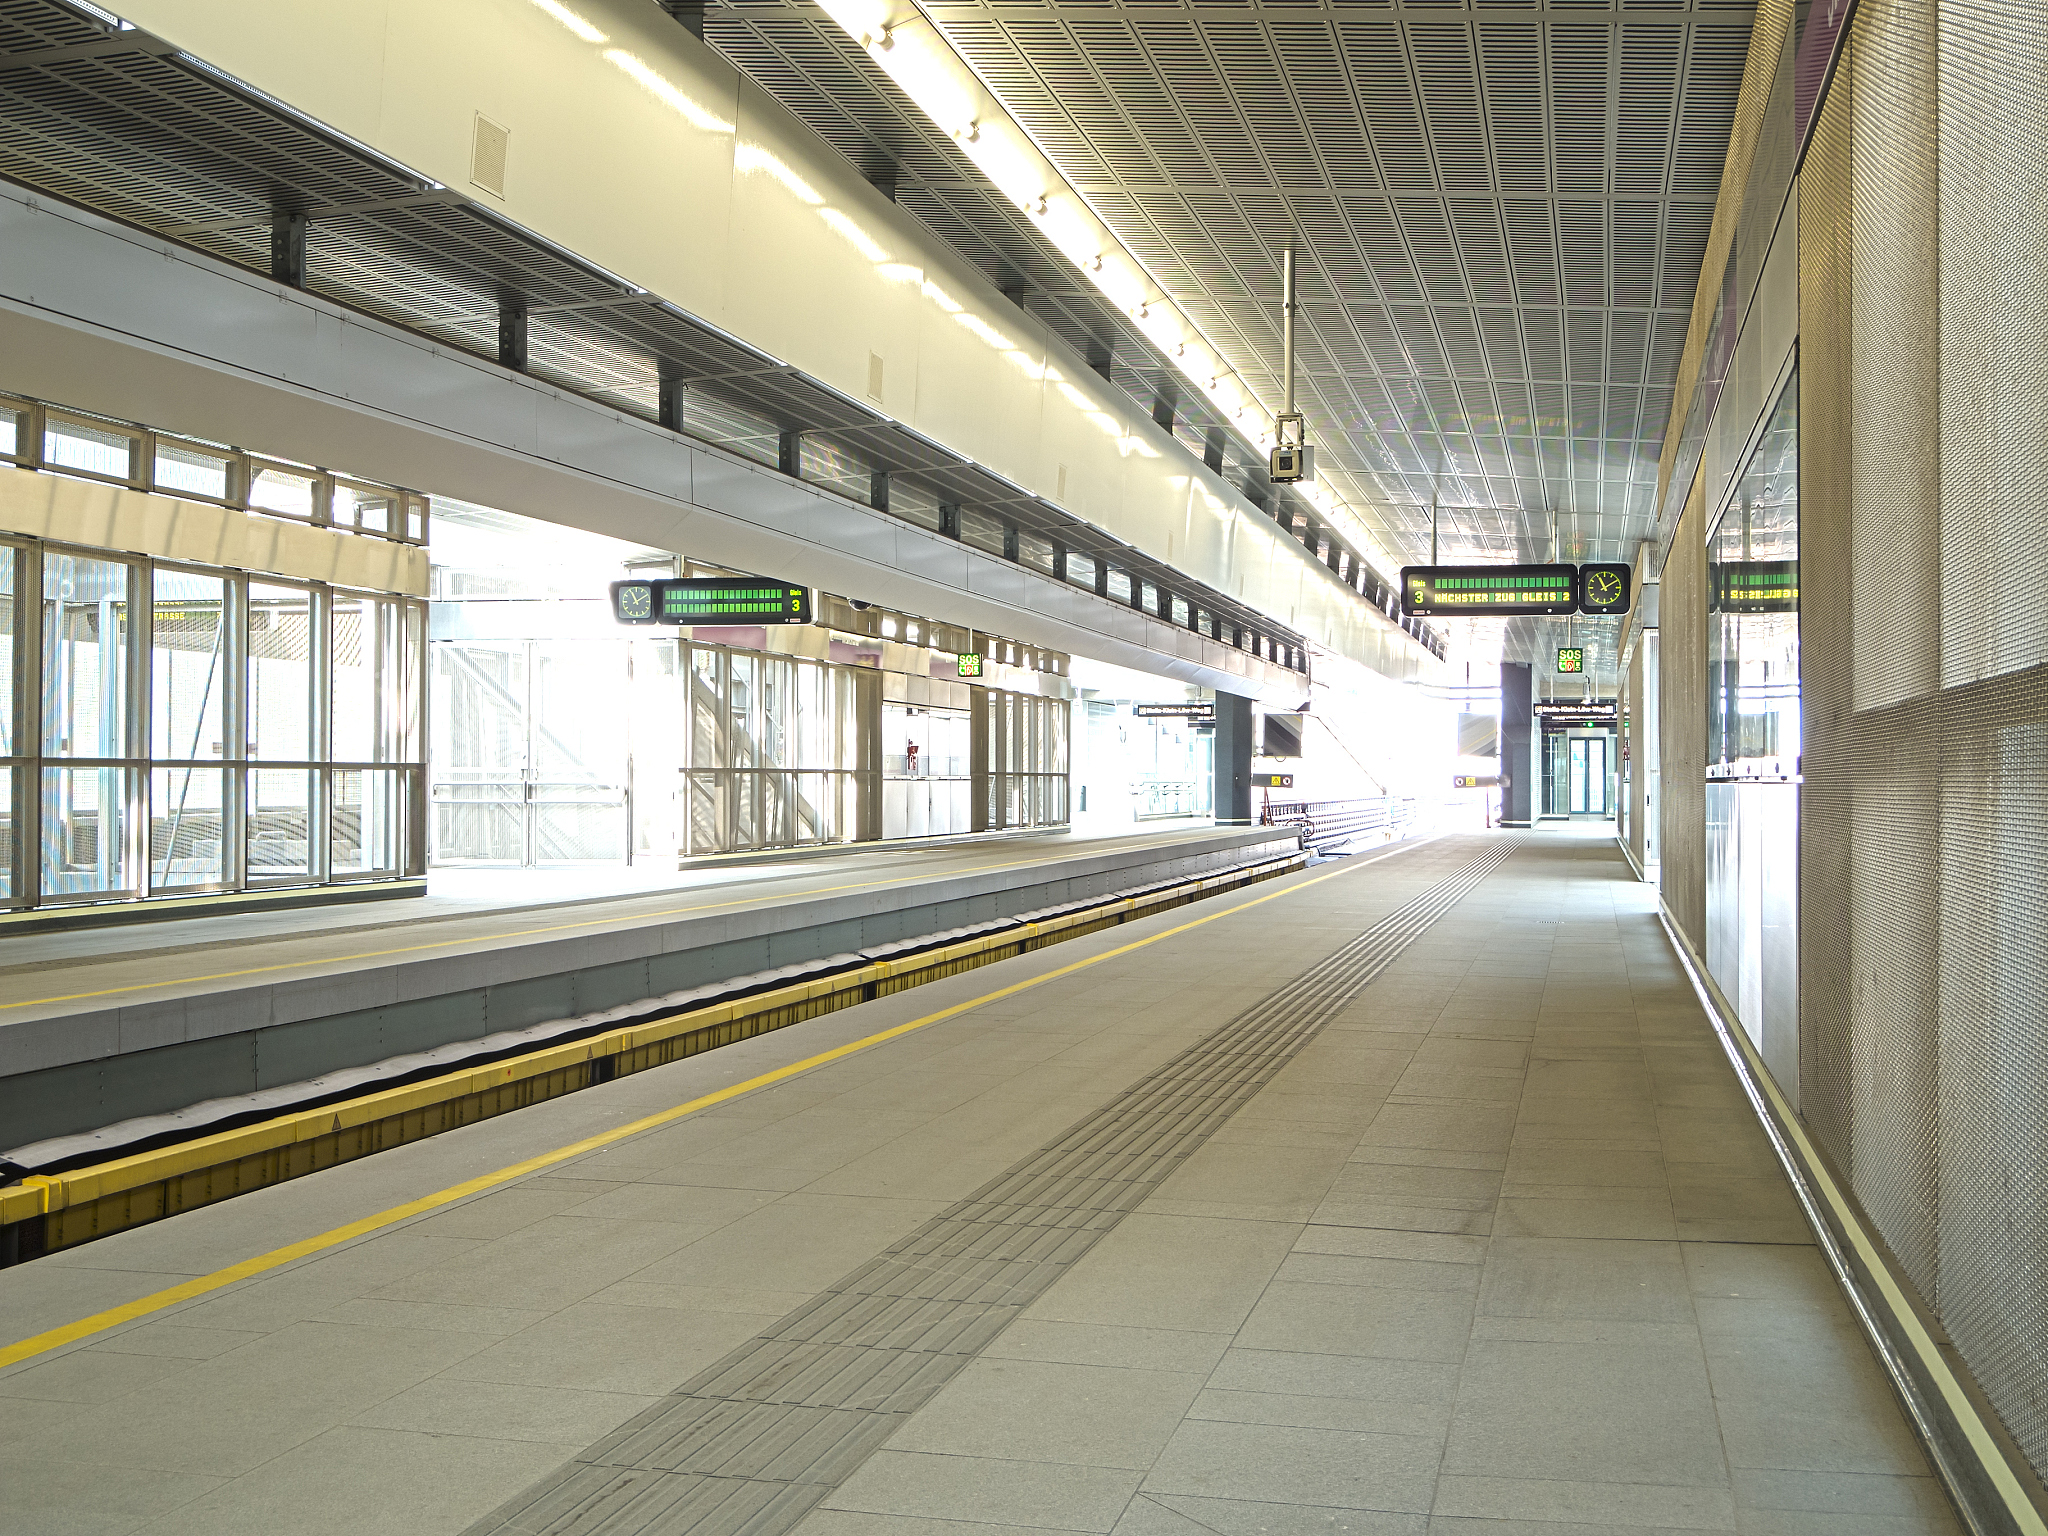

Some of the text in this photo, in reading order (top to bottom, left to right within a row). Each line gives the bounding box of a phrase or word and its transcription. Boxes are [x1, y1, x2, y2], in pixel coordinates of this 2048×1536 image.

[1414, 590, 1424, 604] 3
[1434, 591, 1570, 603] NÄCHSTER ZUG GLEIS 2
[791, 599, 801, 612] 3
[959, 655, 979, 664] SOS
[1559, 650, 1581, 660] SOS
